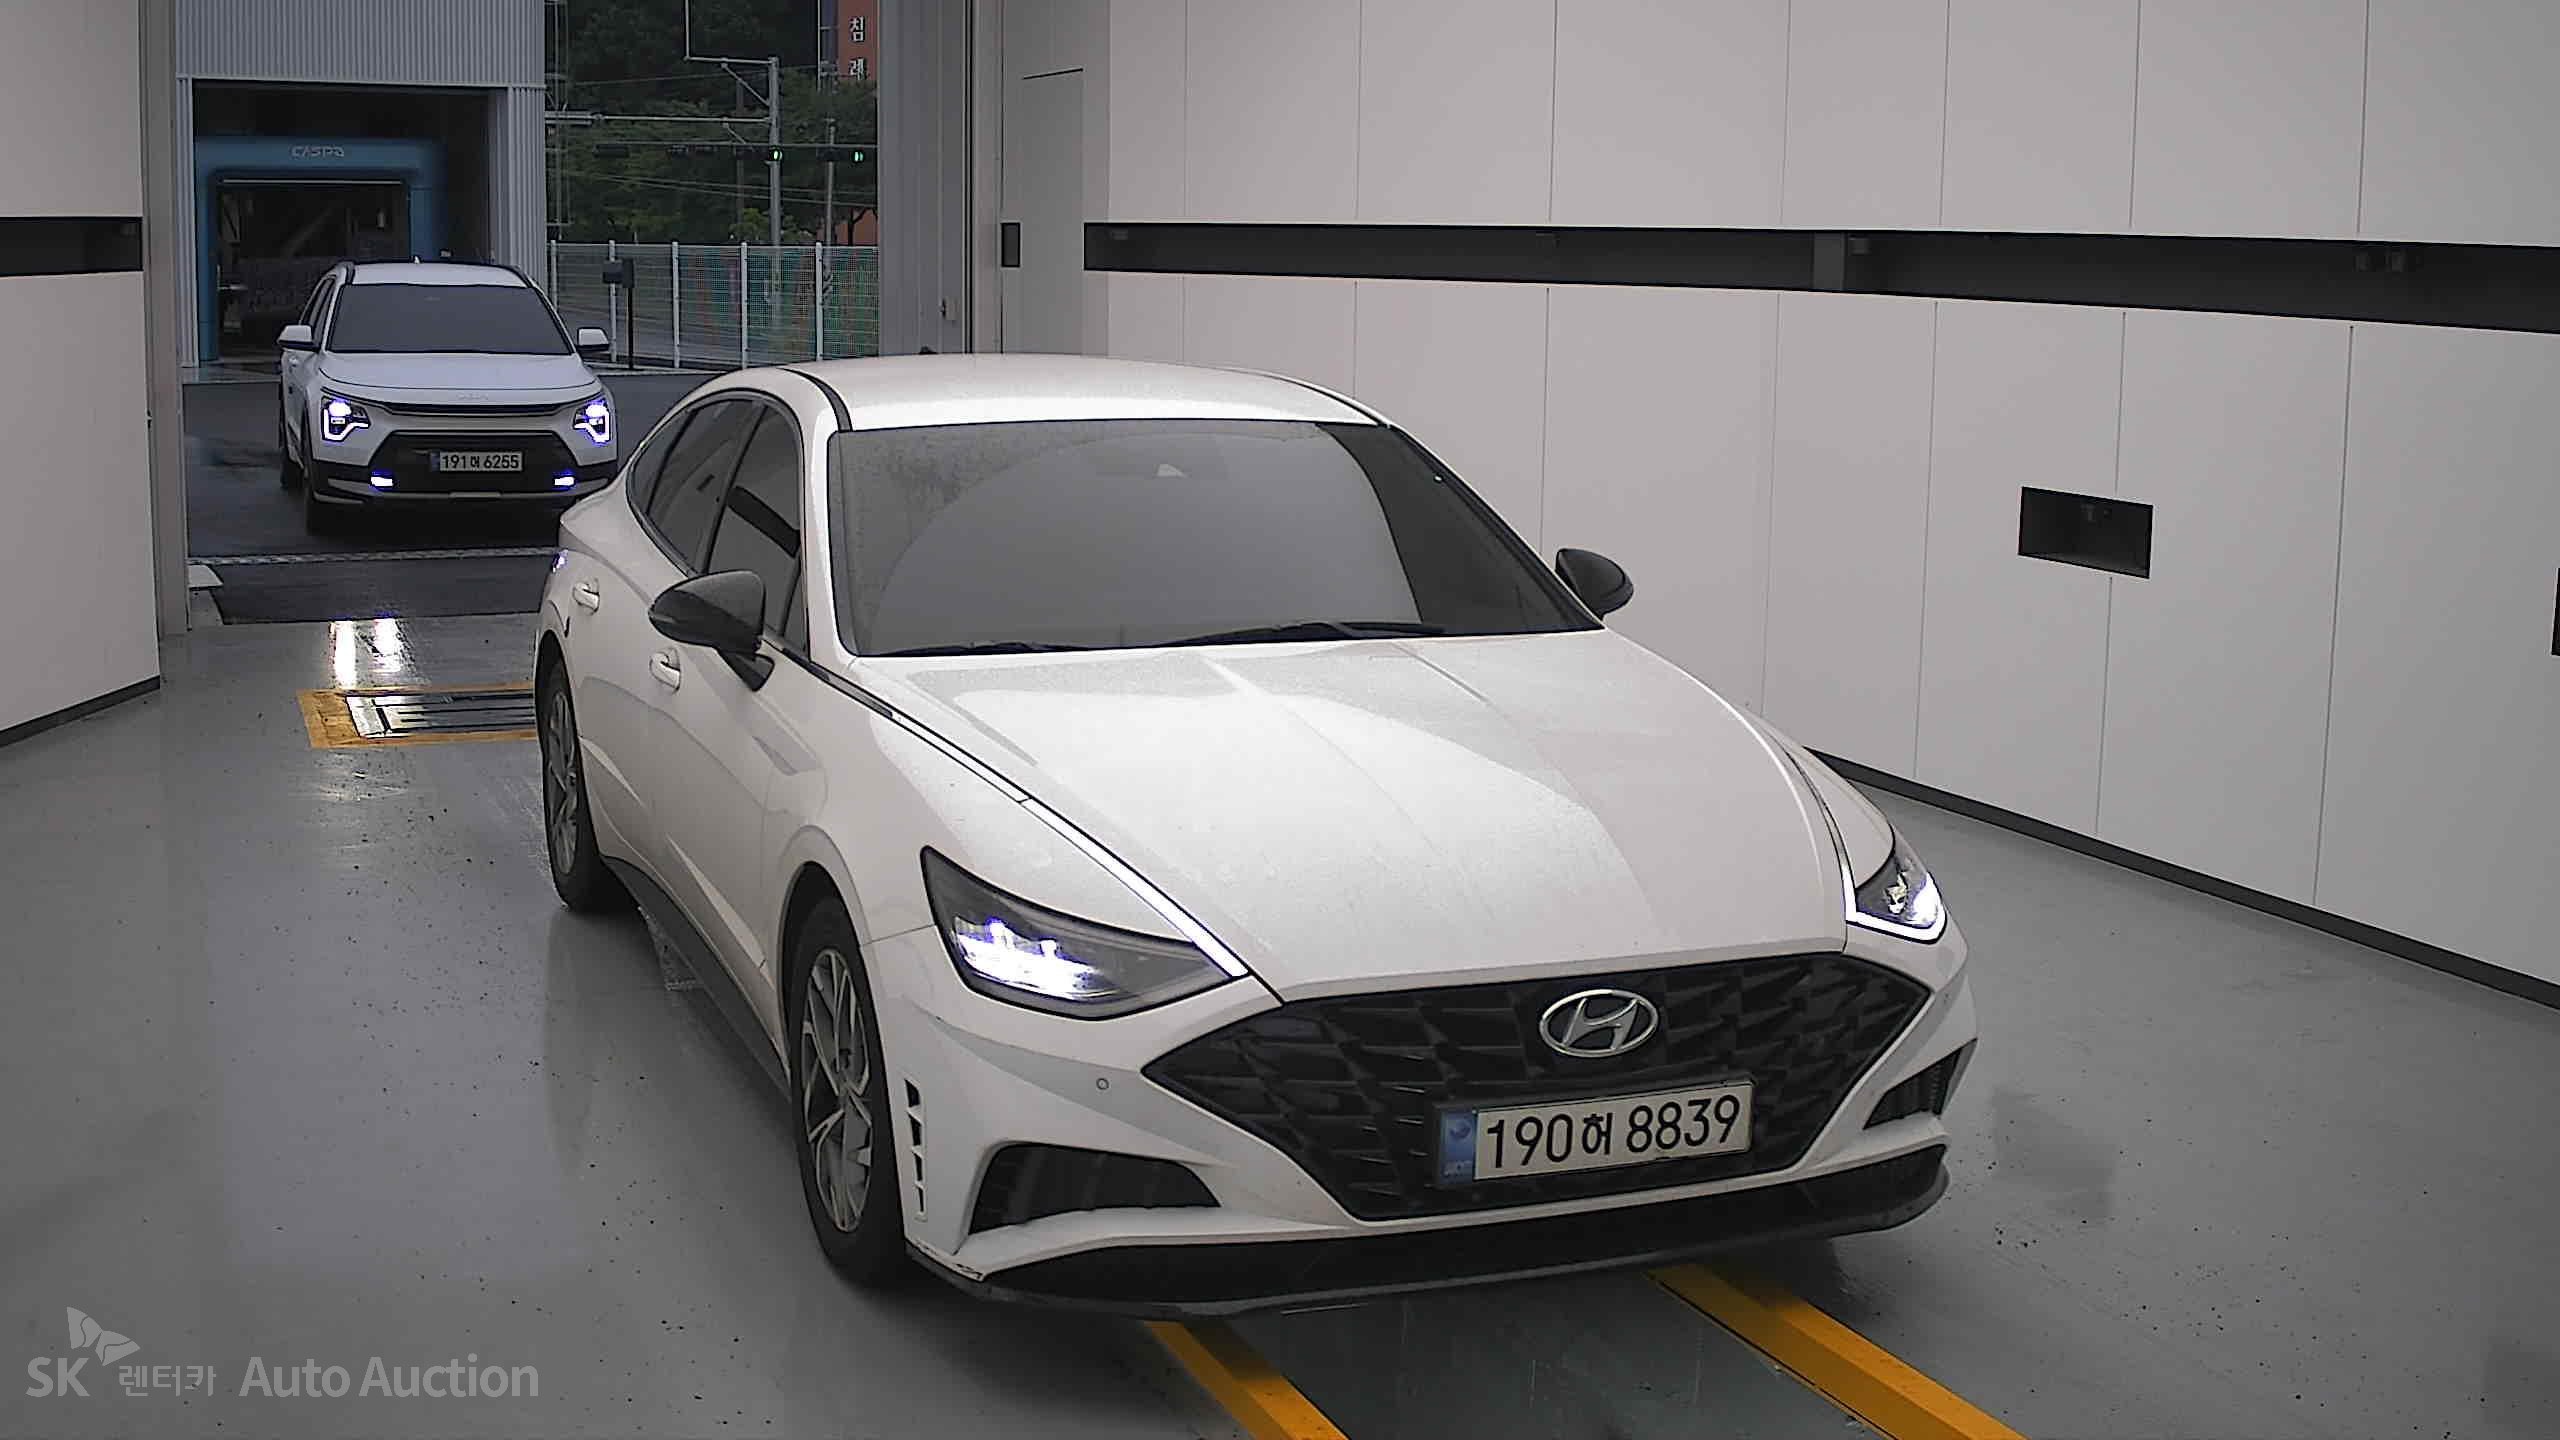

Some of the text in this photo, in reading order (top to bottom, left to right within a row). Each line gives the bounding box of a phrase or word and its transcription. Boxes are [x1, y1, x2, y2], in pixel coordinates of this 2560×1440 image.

[483, 454, 519, 469] 6255
[1487, 1094, 1741, 1169] 190허 8839
